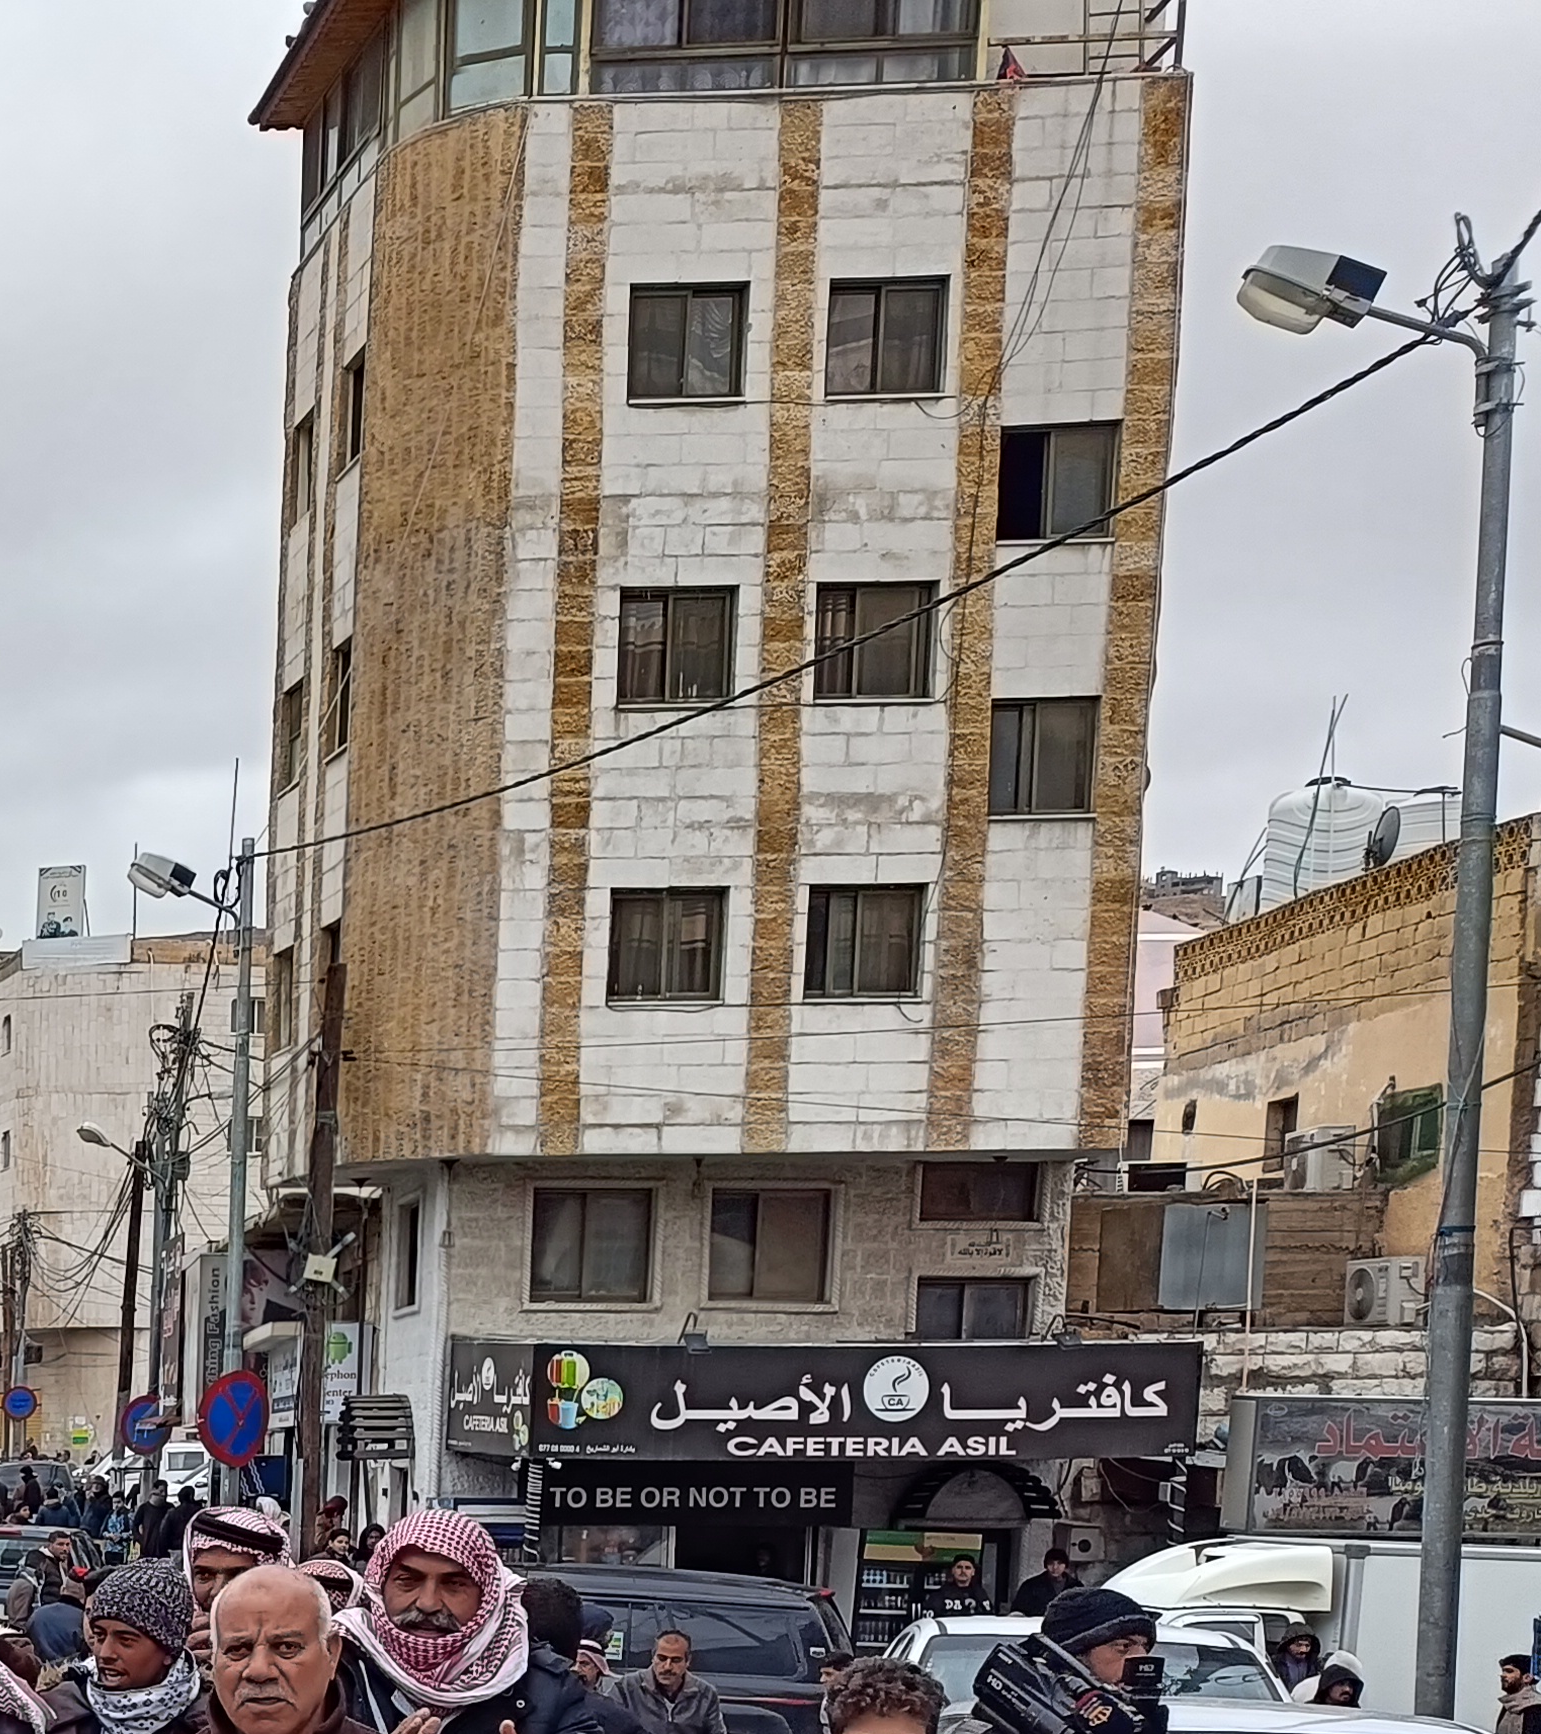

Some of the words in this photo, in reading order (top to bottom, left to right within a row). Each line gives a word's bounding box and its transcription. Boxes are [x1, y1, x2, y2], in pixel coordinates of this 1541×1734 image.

[208, 1267, 220, 1336] Fashion
[325, 1388, 353, 1397] enter
[650, 1373, 852, 1433] الأصيل
[887, 1397, 904, 1407] CA
[940, 1372, 1169, 1432] كافتريا
[463, 1414, 495, 1433] CAFETERIA
[494, 1416, 509, 1433] ASIL
[726, 1435, 929, 1458] CAFETERIA
[935, 1435, 1017, 1457] ASIL
[549, 1486, 587, 1508] TO
[595, 1486, 632, 1508] BE
[640, 1486, 682, 1508] OR
[689, 1486, 747, 1508] NOT
[753, 1486, 792, 1508] TO
[799, 1486, 837, 1508] BE
[986, 1674, 1004, 1691] HD
